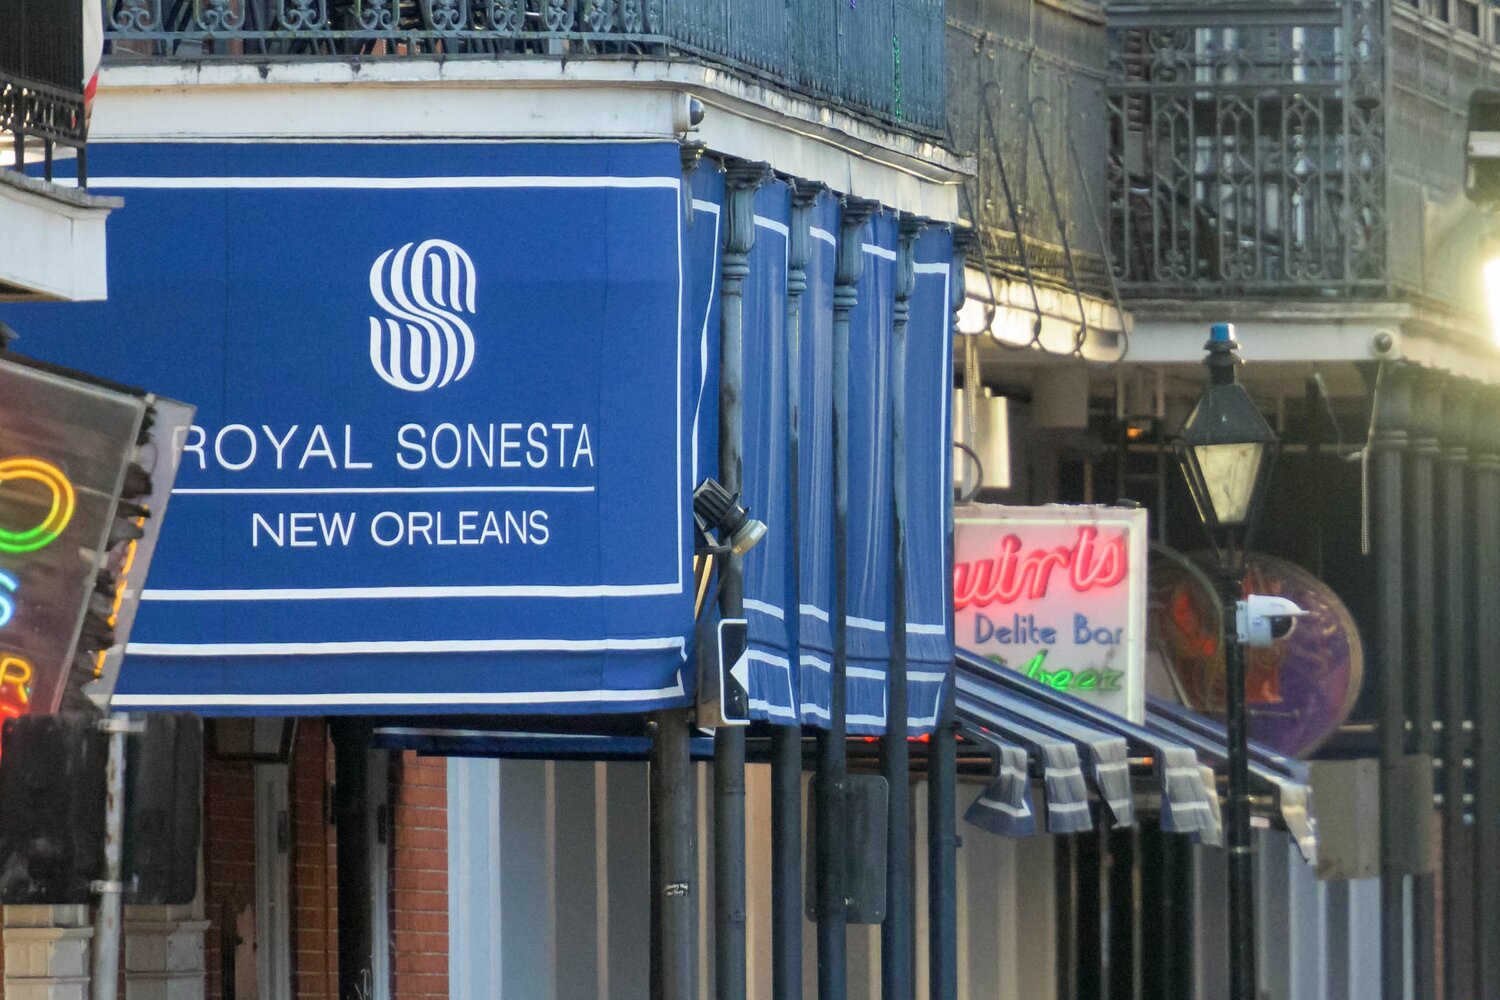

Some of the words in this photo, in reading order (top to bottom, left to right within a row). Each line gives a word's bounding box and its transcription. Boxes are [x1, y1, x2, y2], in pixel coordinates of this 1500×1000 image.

[172, 424, 373, 471] ROYAL
[395, 422, 595, 470] SONESTA
[252, 511, 357, 547] NEW
[370, 509, 550, 547] ORLEANS
[974, 613, 1057, 645] Delite
[1073, 613, 1124, 645] Bar
